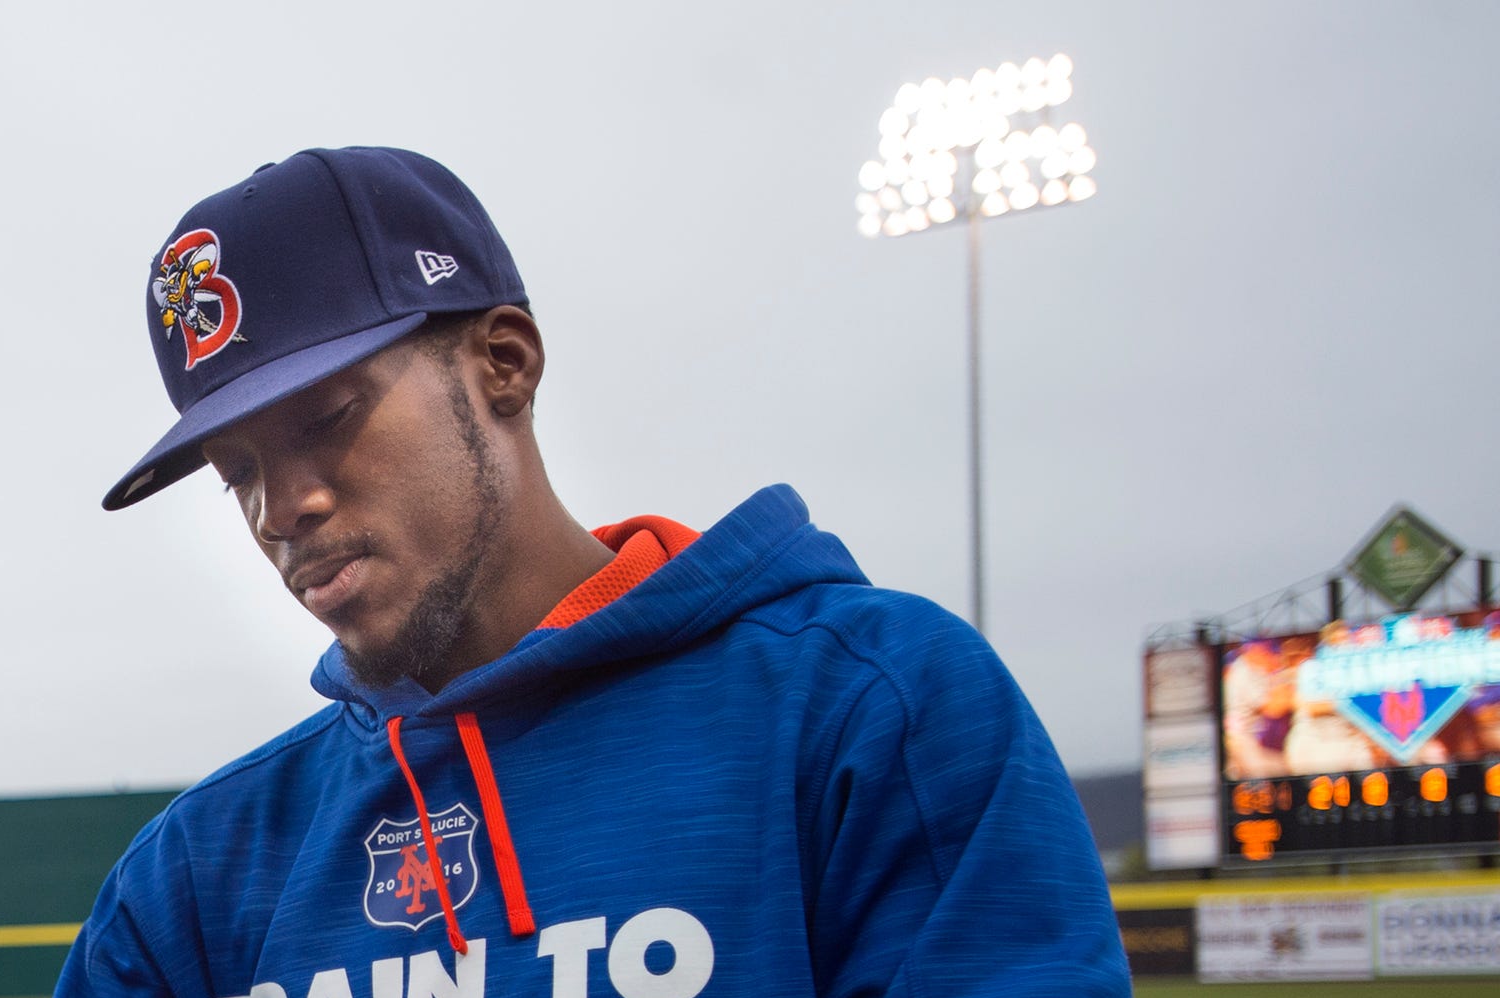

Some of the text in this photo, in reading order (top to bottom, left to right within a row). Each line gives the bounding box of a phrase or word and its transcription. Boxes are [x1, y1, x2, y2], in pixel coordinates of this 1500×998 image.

[377, 831, 412, 845] PORT
[431, 815, 467, 833] LUCIE
[375, 862, 463, 894] 20 16
